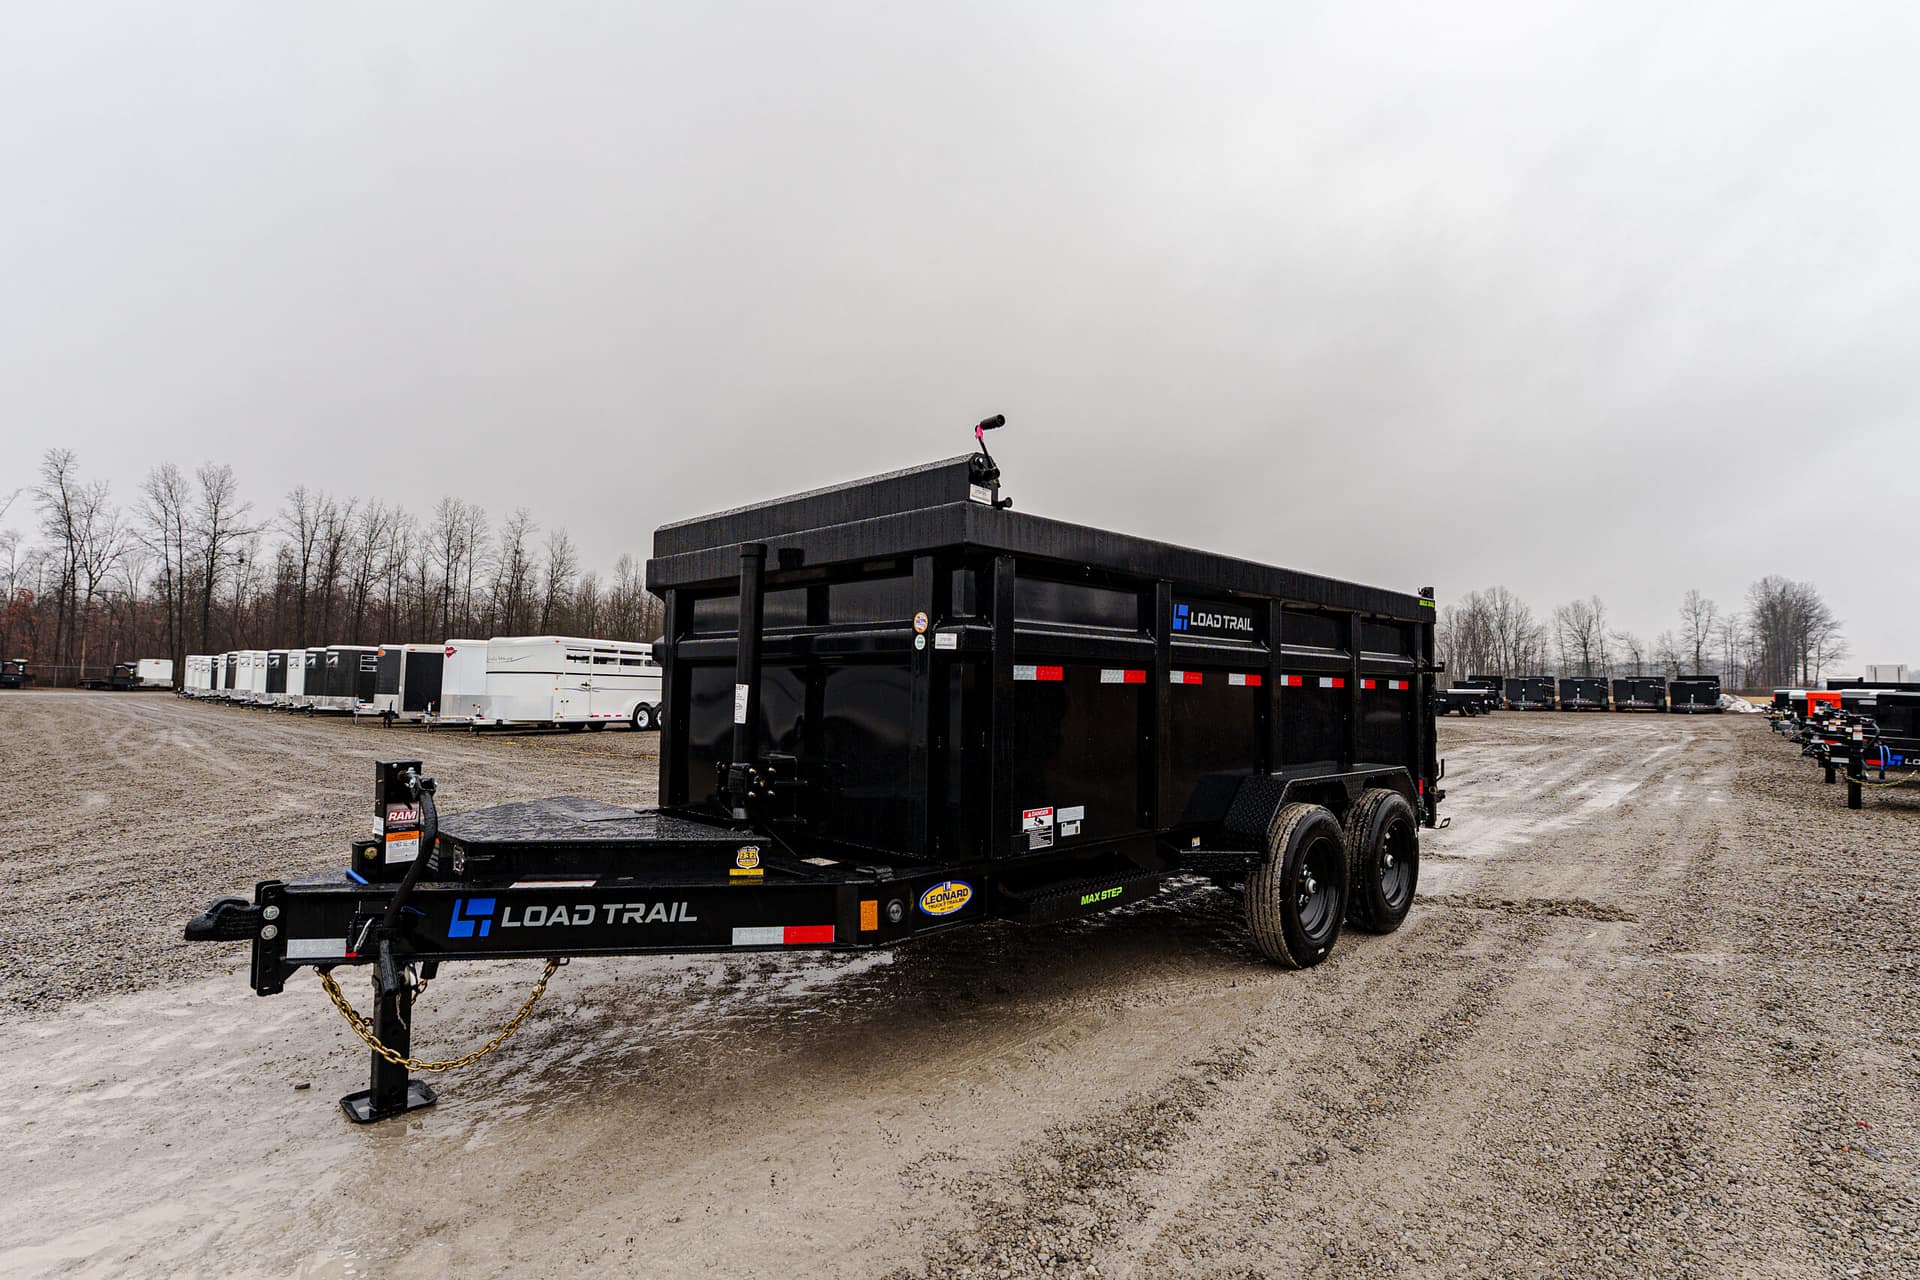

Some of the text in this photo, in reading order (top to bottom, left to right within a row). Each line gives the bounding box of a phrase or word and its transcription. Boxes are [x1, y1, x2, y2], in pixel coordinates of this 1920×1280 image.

[1190, 611, 1254, 631] LOAD TRAIL
[388, 811, 416, 821] RAM
[925, 888, 969, 904] LEONARD
[1080, 886, 1123, 905] MAX STEP
[501, 902, 698, 927] LOAD TRAIL
